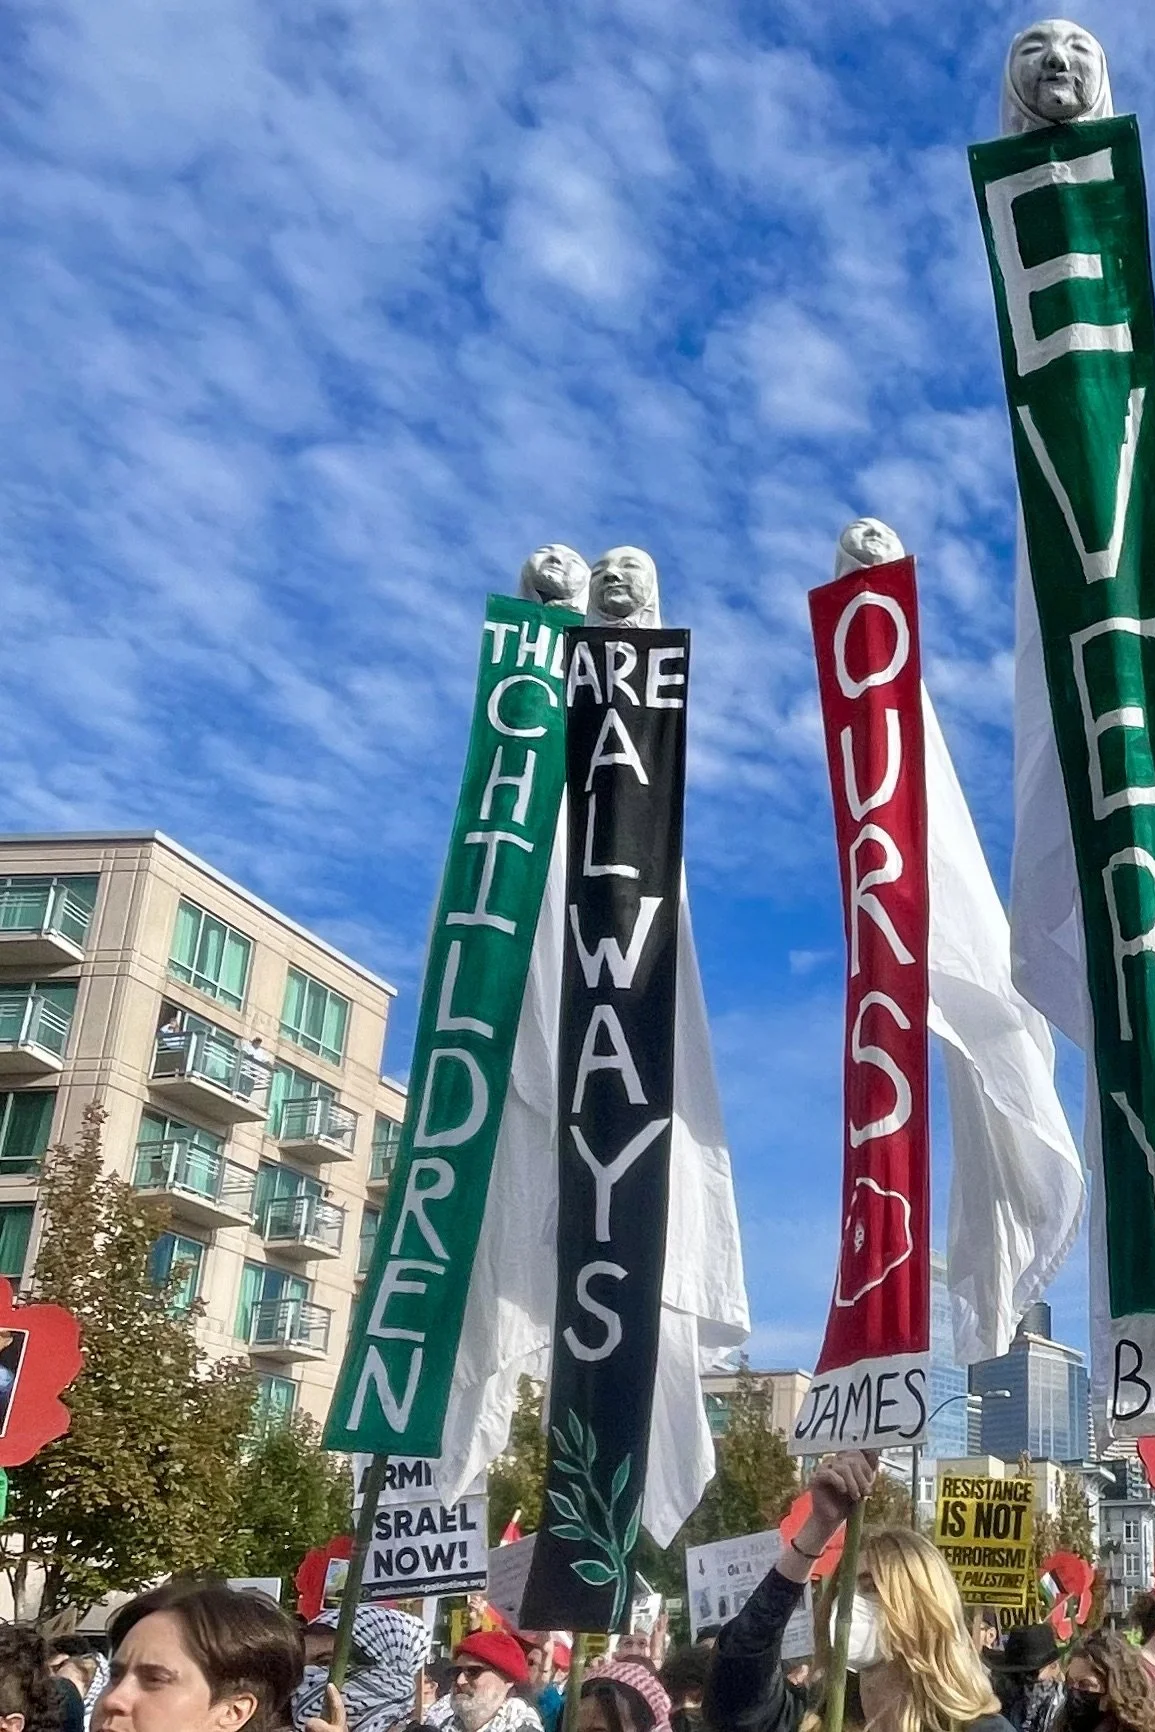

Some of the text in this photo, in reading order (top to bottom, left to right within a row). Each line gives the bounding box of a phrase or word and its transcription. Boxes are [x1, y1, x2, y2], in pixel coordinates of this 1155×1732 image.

[567, 641, 686, 709] ARE
[833, 589, 914, 1149] OURS
[346, 674, 558, 1434] CHILDREN
[562, 708, 670, 1362] ALWAYS
[794, 1368, 926, 1442] JAMES
[375, 1503, 477, 1540] SRAEL
[941, 1500, 1026, 1541] IS NOT
[942, 1478, 1032, 1503] RESISTANCE
[374, 1541, 469, 1578] NOW!
